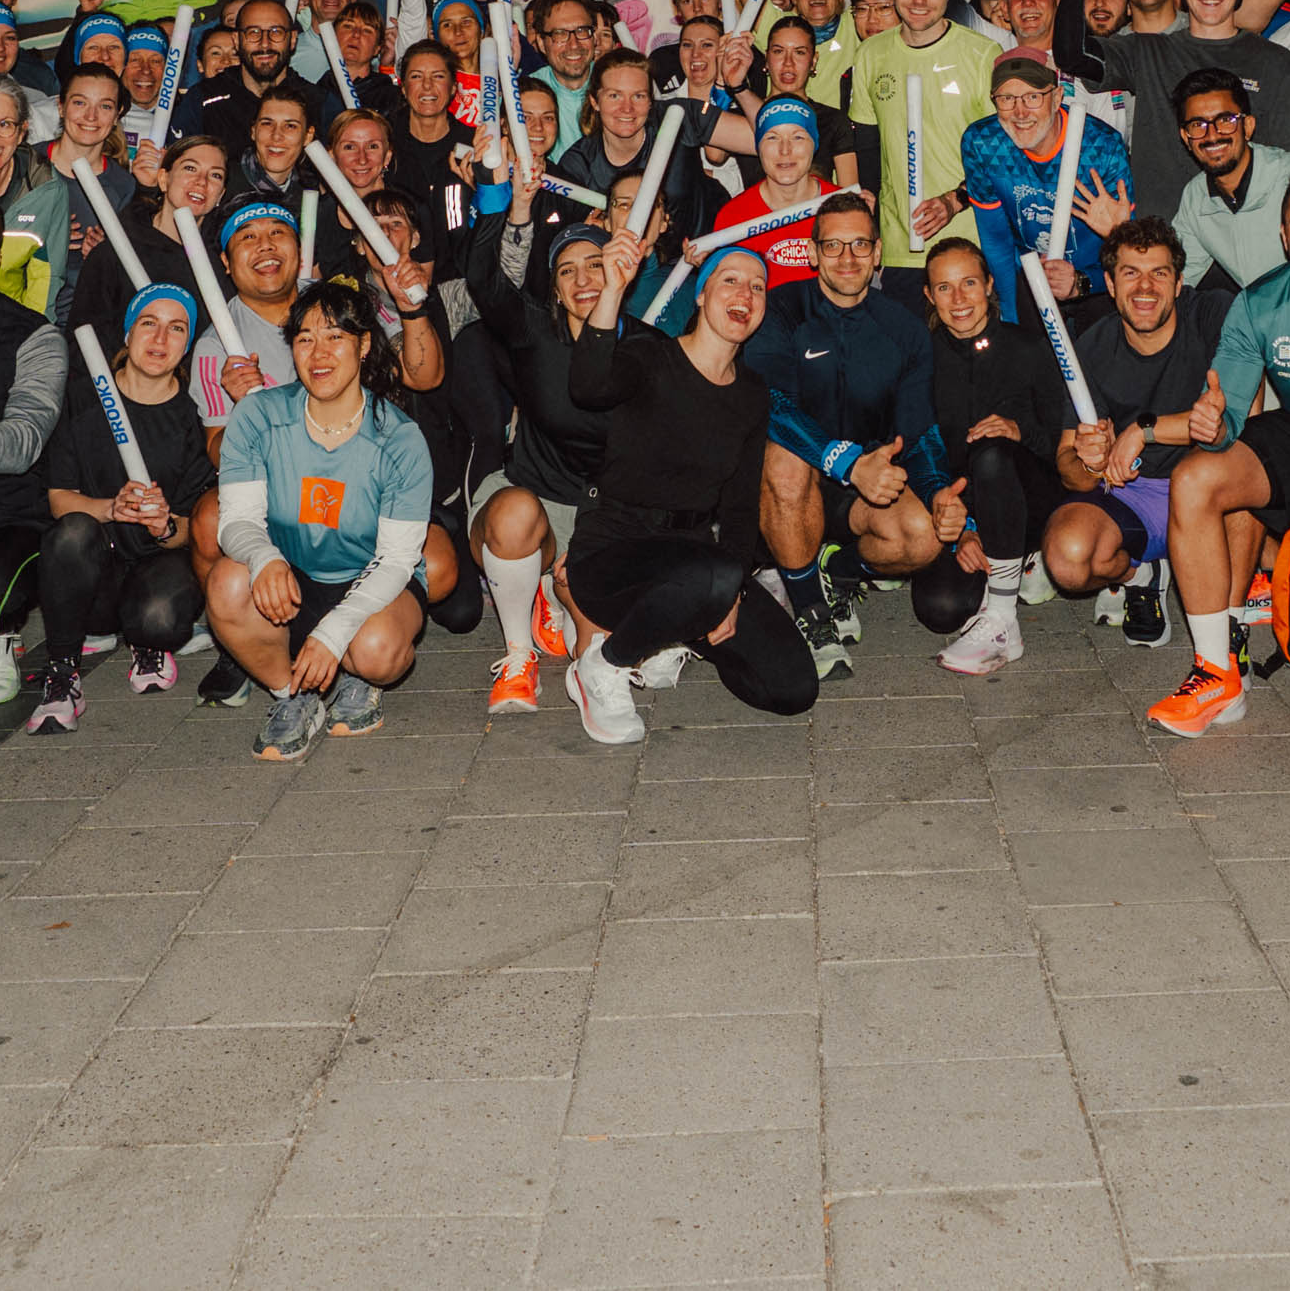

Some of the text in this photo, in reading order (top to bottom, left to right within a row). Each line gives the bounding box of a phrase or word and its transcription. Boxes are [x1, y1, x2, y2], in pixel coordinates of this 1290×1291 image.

[158, 47, 181, 110] BROOKS
[483, 76, 497, 122] BROOKS
[747, 208, 813, 238] BROOKS
[93, 373, 129, 445] BROOKS
